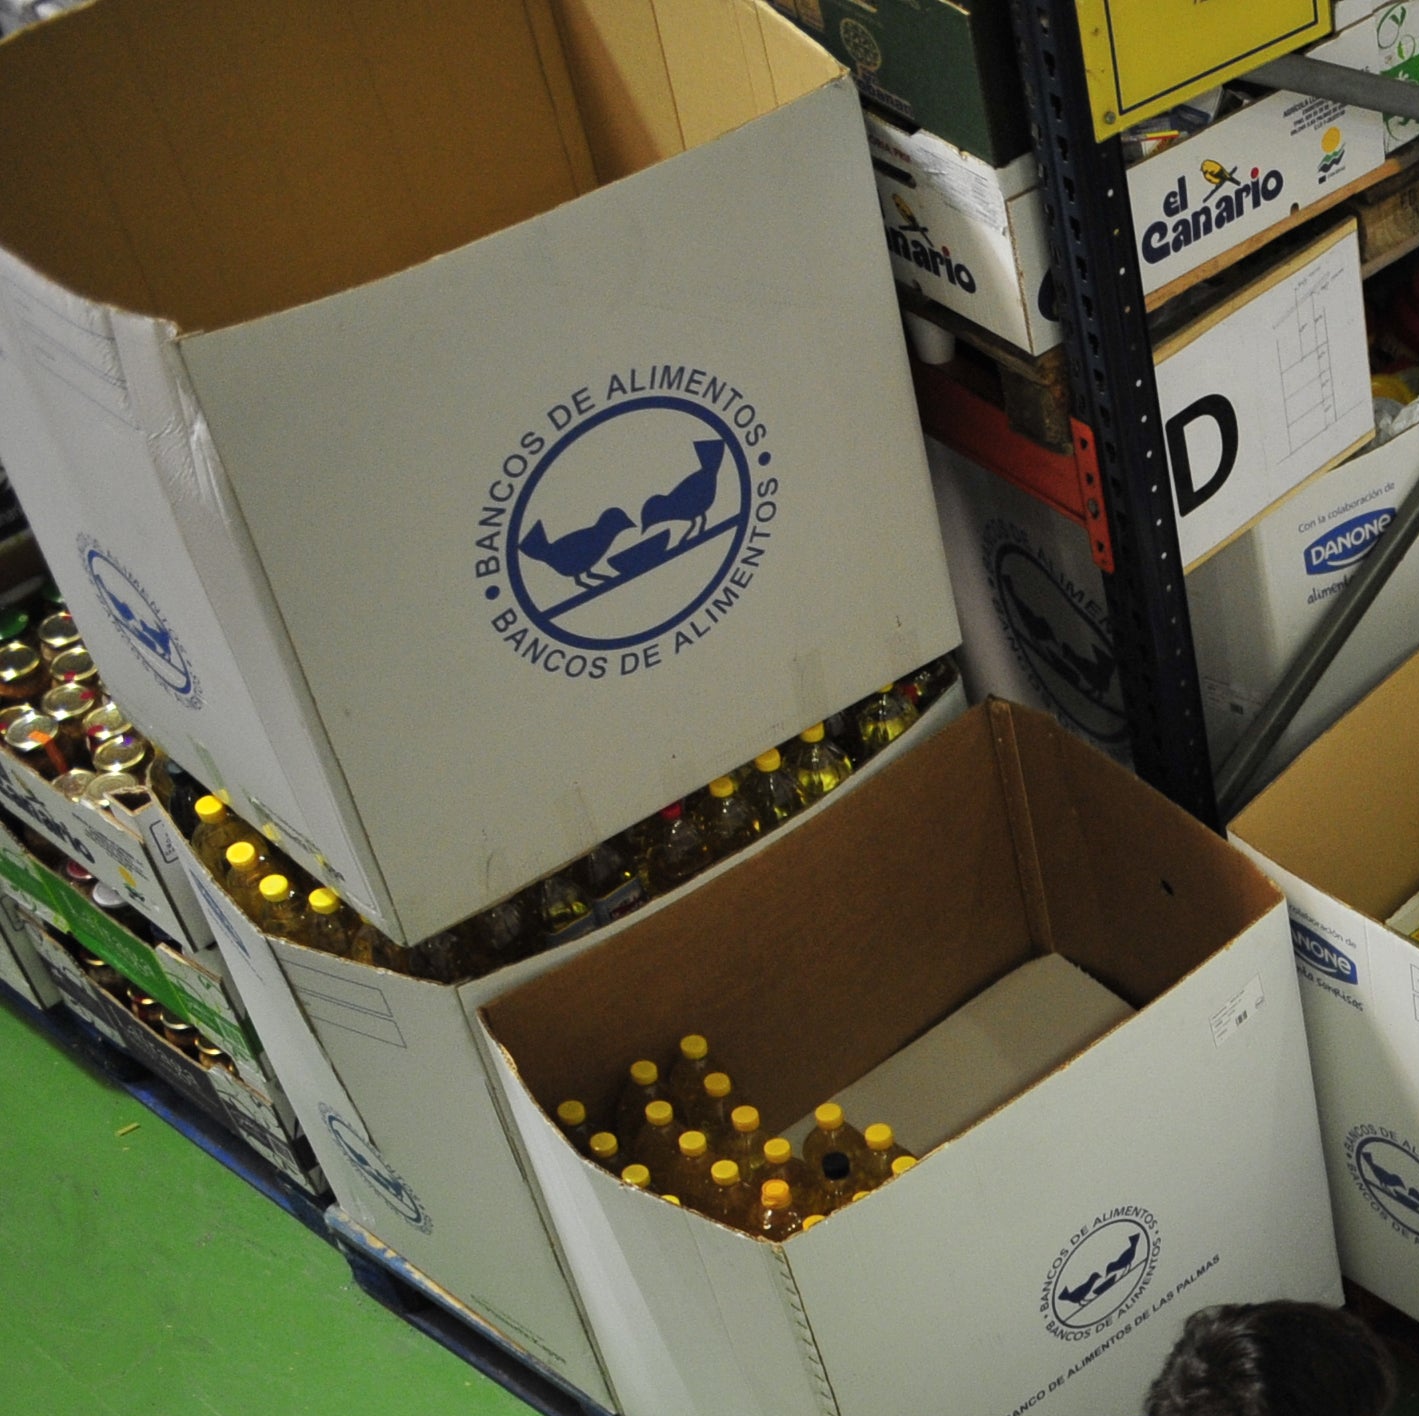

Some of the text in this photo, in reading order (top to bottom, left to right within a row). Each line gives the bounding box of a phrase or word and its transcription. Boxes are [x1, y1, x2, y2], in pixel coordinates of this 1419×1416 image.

[1141, 167, 1284, 264] Canario
[1163, 175, 1188, 217] el
[475, 365, 767, 578] BANCOS DE ALIMENTOS
[1164, 393, 1239, 518] D
[1298, 481, 1395, 534] Con la colaboración de
[491, 477, 778, 679] BANCOS DE ALIMENTOS
[1345, 936, 1357, 949] de
[1344, 1124, 1377, 1153] BANCOS
[1380, 1126, 1398, 1140] DE
[1347, 1163, 1388, 1220] BANCOS
[1392, 1221, 1410, 1239] DE
[1040, 1206, 1158, 1313] BANCOS DE ALIMENTOS
[1046, 1238, 1161, 1342] BANCOS DE ALIMENTOS
[1048, 1376, 1065, 1392] DE
[1067, 1323, 1132, 1378] ALIMENTOS
[1134, 1311, 1150, 1327] DE
[1152, 1291, 1174, 1313] LAS
[1176, 1254, 1220, 1294] PALMAS
